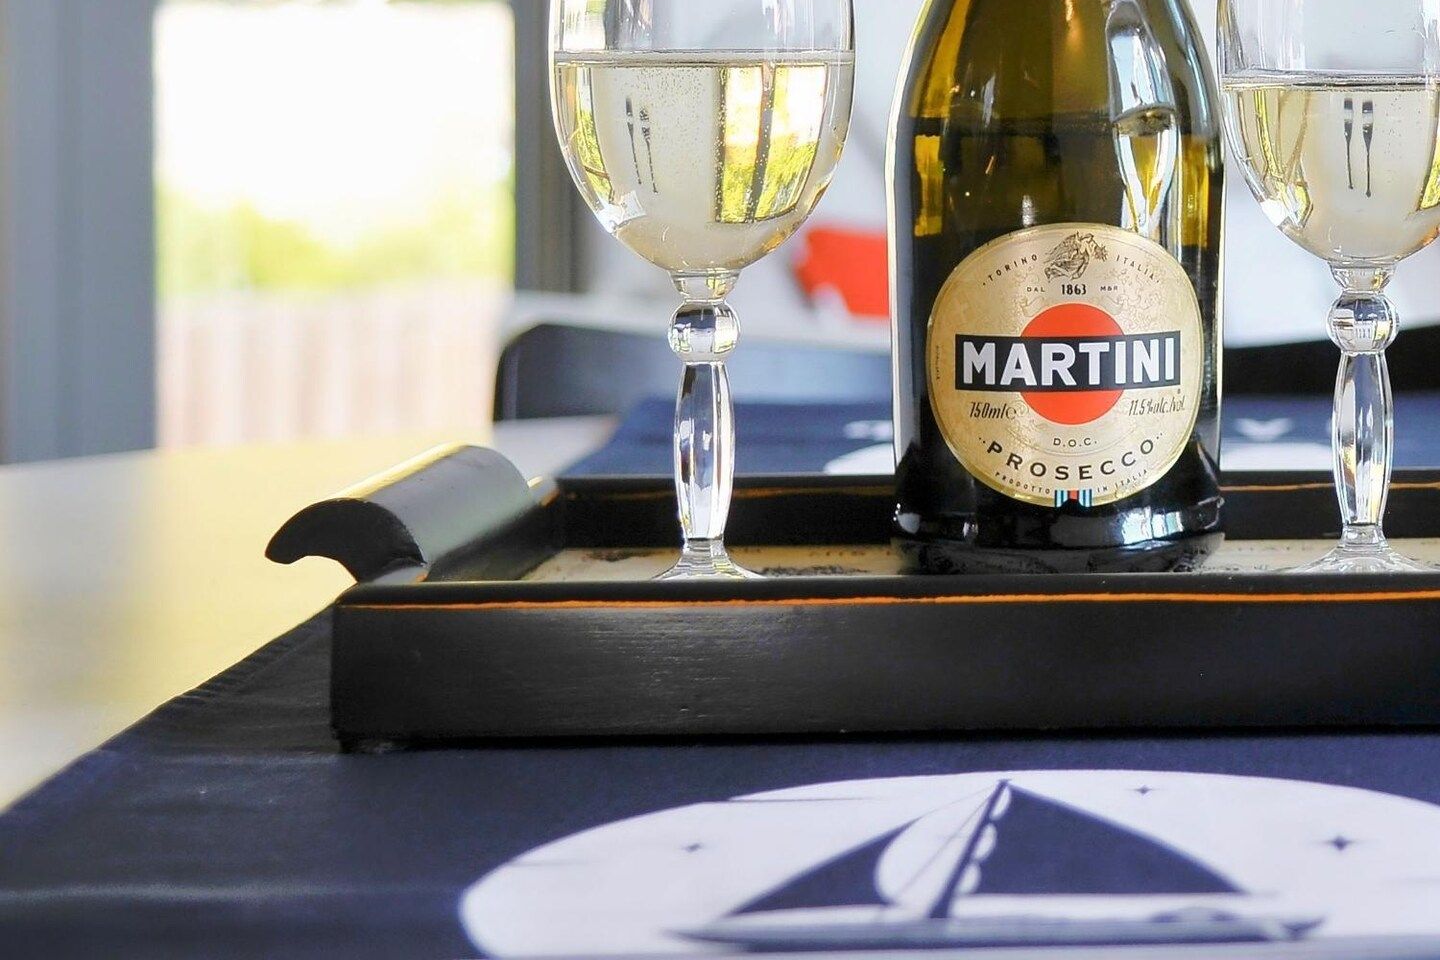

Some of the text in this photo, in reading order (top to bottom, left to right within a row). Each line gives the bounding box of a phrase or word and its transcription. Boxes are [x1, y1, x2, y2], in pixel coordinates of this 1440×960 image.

[988, 253, 1155, 282] TORINO ITALIA
[1061, 283, 1087, 295] 1863
[962, 337, 1175, 386] MARTINI
[1053, 437, 1098, 447] D.O.C.
[987, 439, 1154, 481] PROSECCO
[994, 471, 1051, 495] PRODOTTO
[1115, 469, 1148, 488] ITALIA
